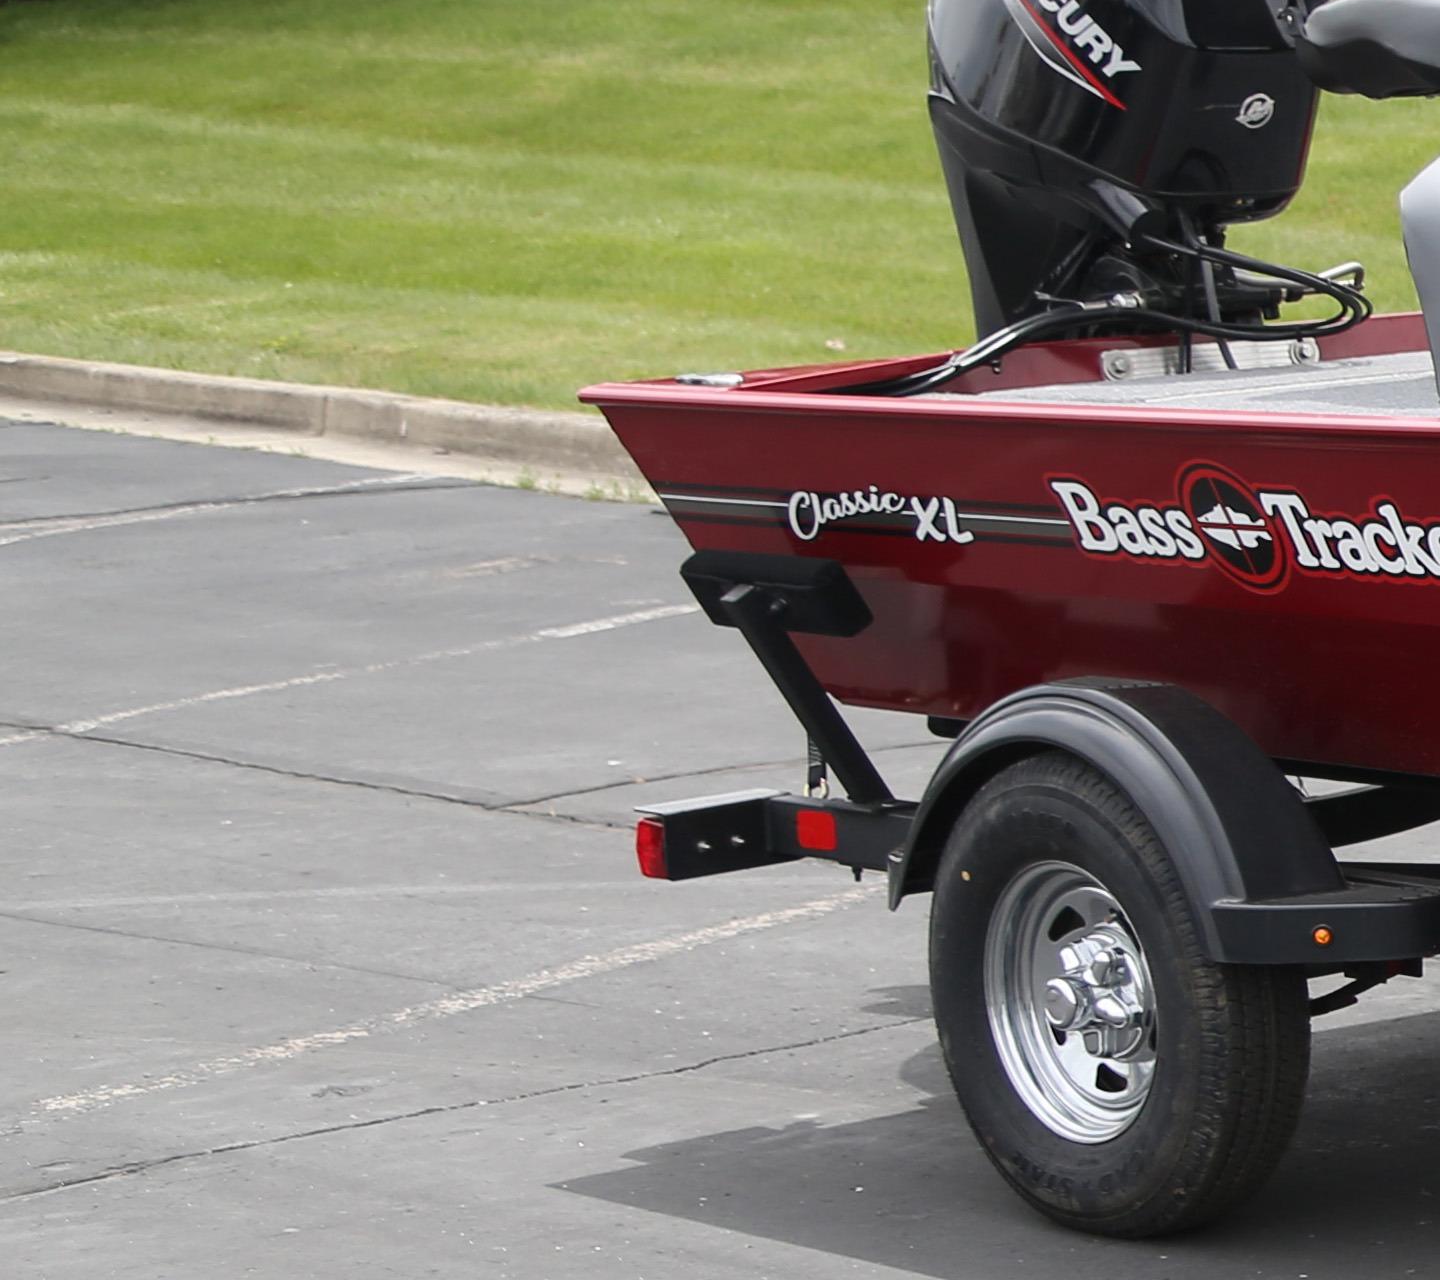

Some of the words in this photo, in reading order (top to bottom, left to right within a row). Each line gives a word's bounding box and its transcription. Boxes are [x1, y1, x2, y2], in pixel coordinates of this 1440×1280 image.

[788, 484, 906, 540] Classic
[910, 496, 975, 544] XL
[1050, 480, 1205, 559] Bass
